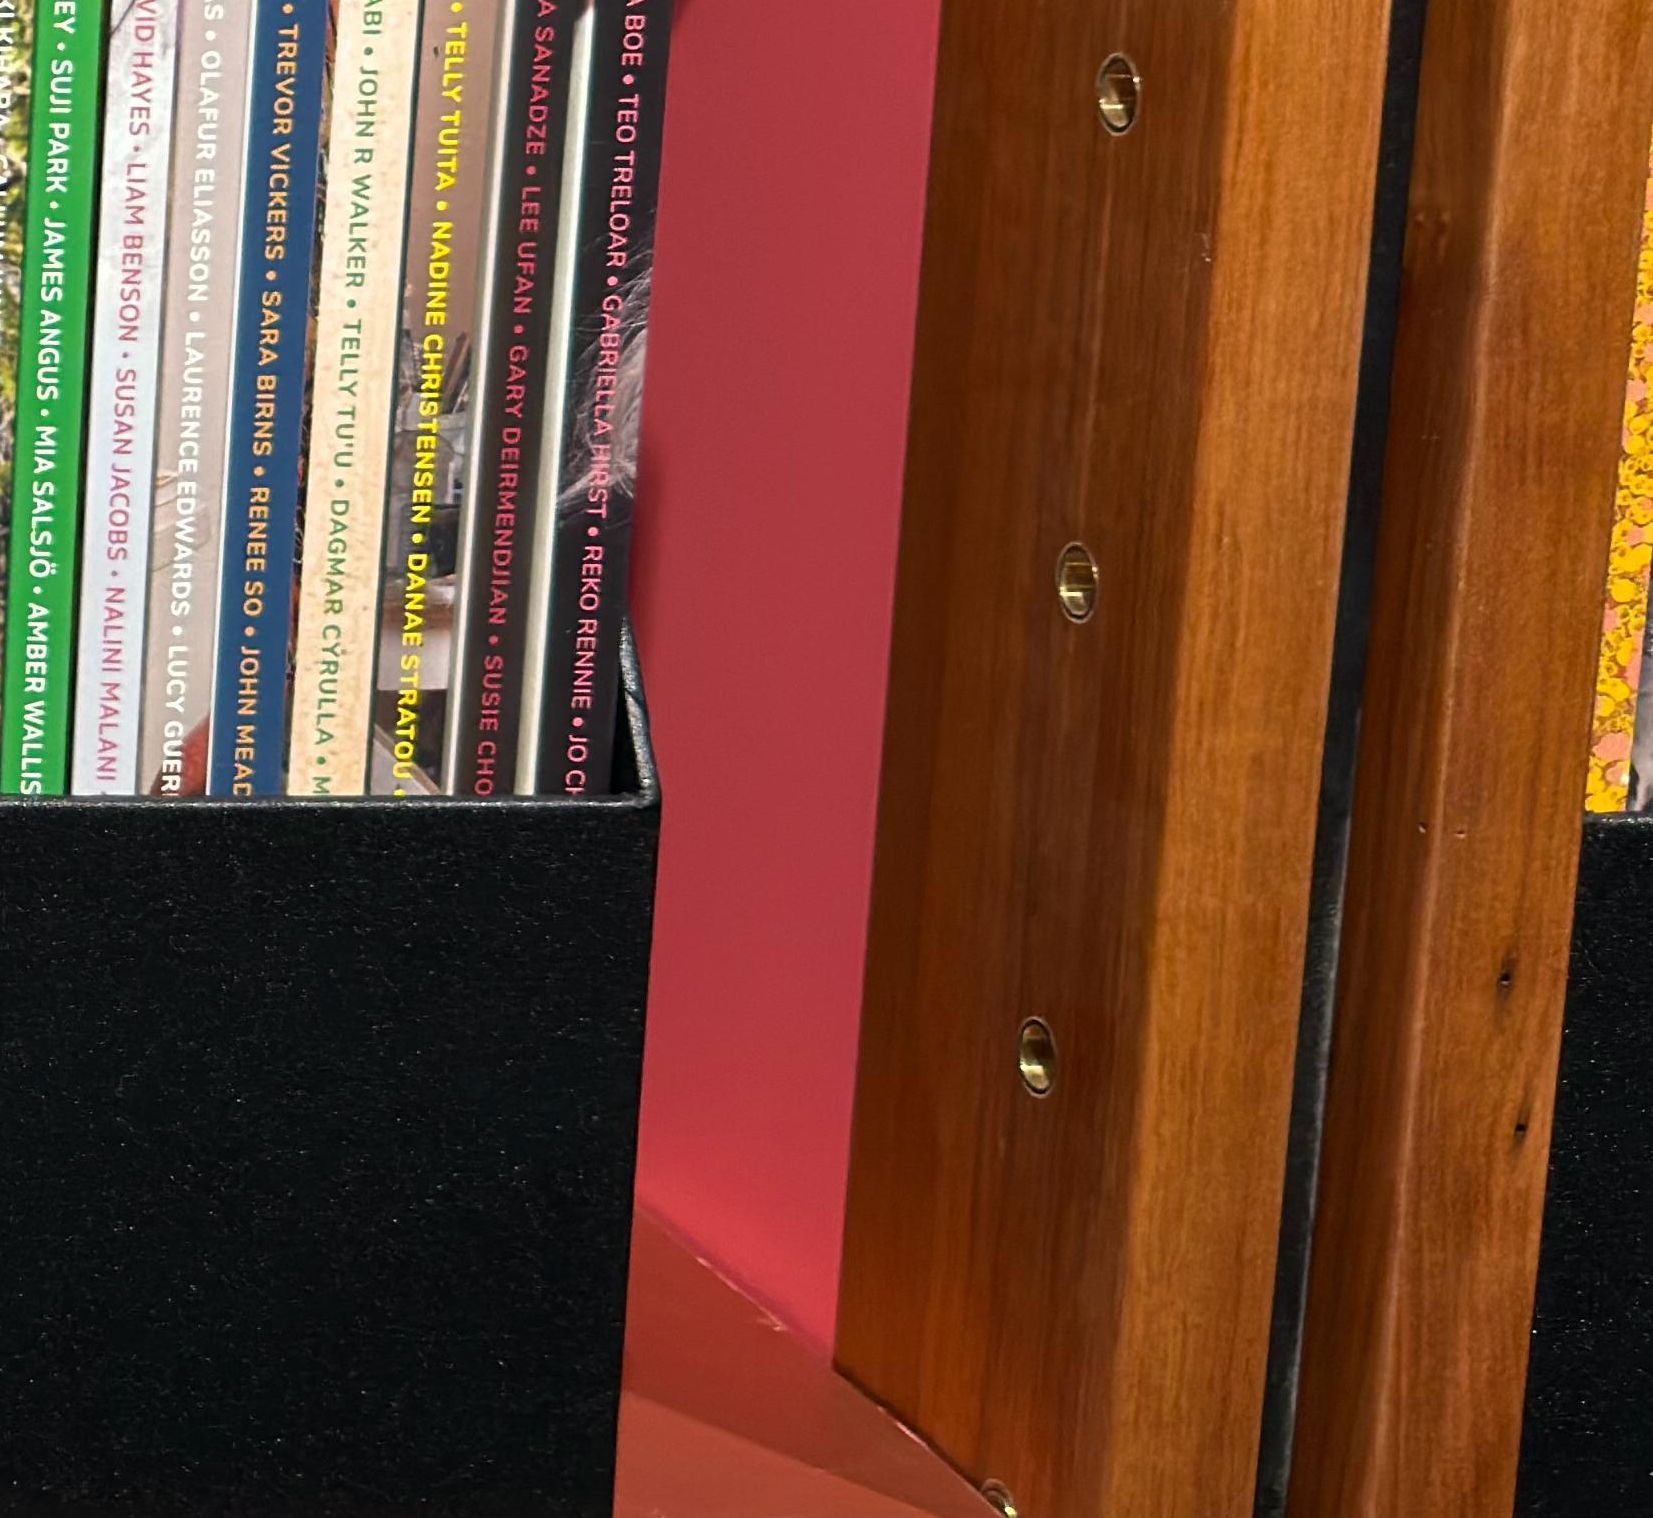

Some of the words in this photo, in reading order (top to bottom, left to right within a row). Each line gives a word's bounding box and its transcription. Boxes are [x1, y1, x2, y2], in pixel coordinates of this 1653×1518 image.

[258, 291, 282, 365] SARA
[113, 369, 136, 454] SUSAN
[179, 332, 205, 473] LAURENCE
[253, 376, 276, 455] BIRNS
[107, 463, 131, 560] JACOBS
[171, 482, 197, 616] EDWARDS
